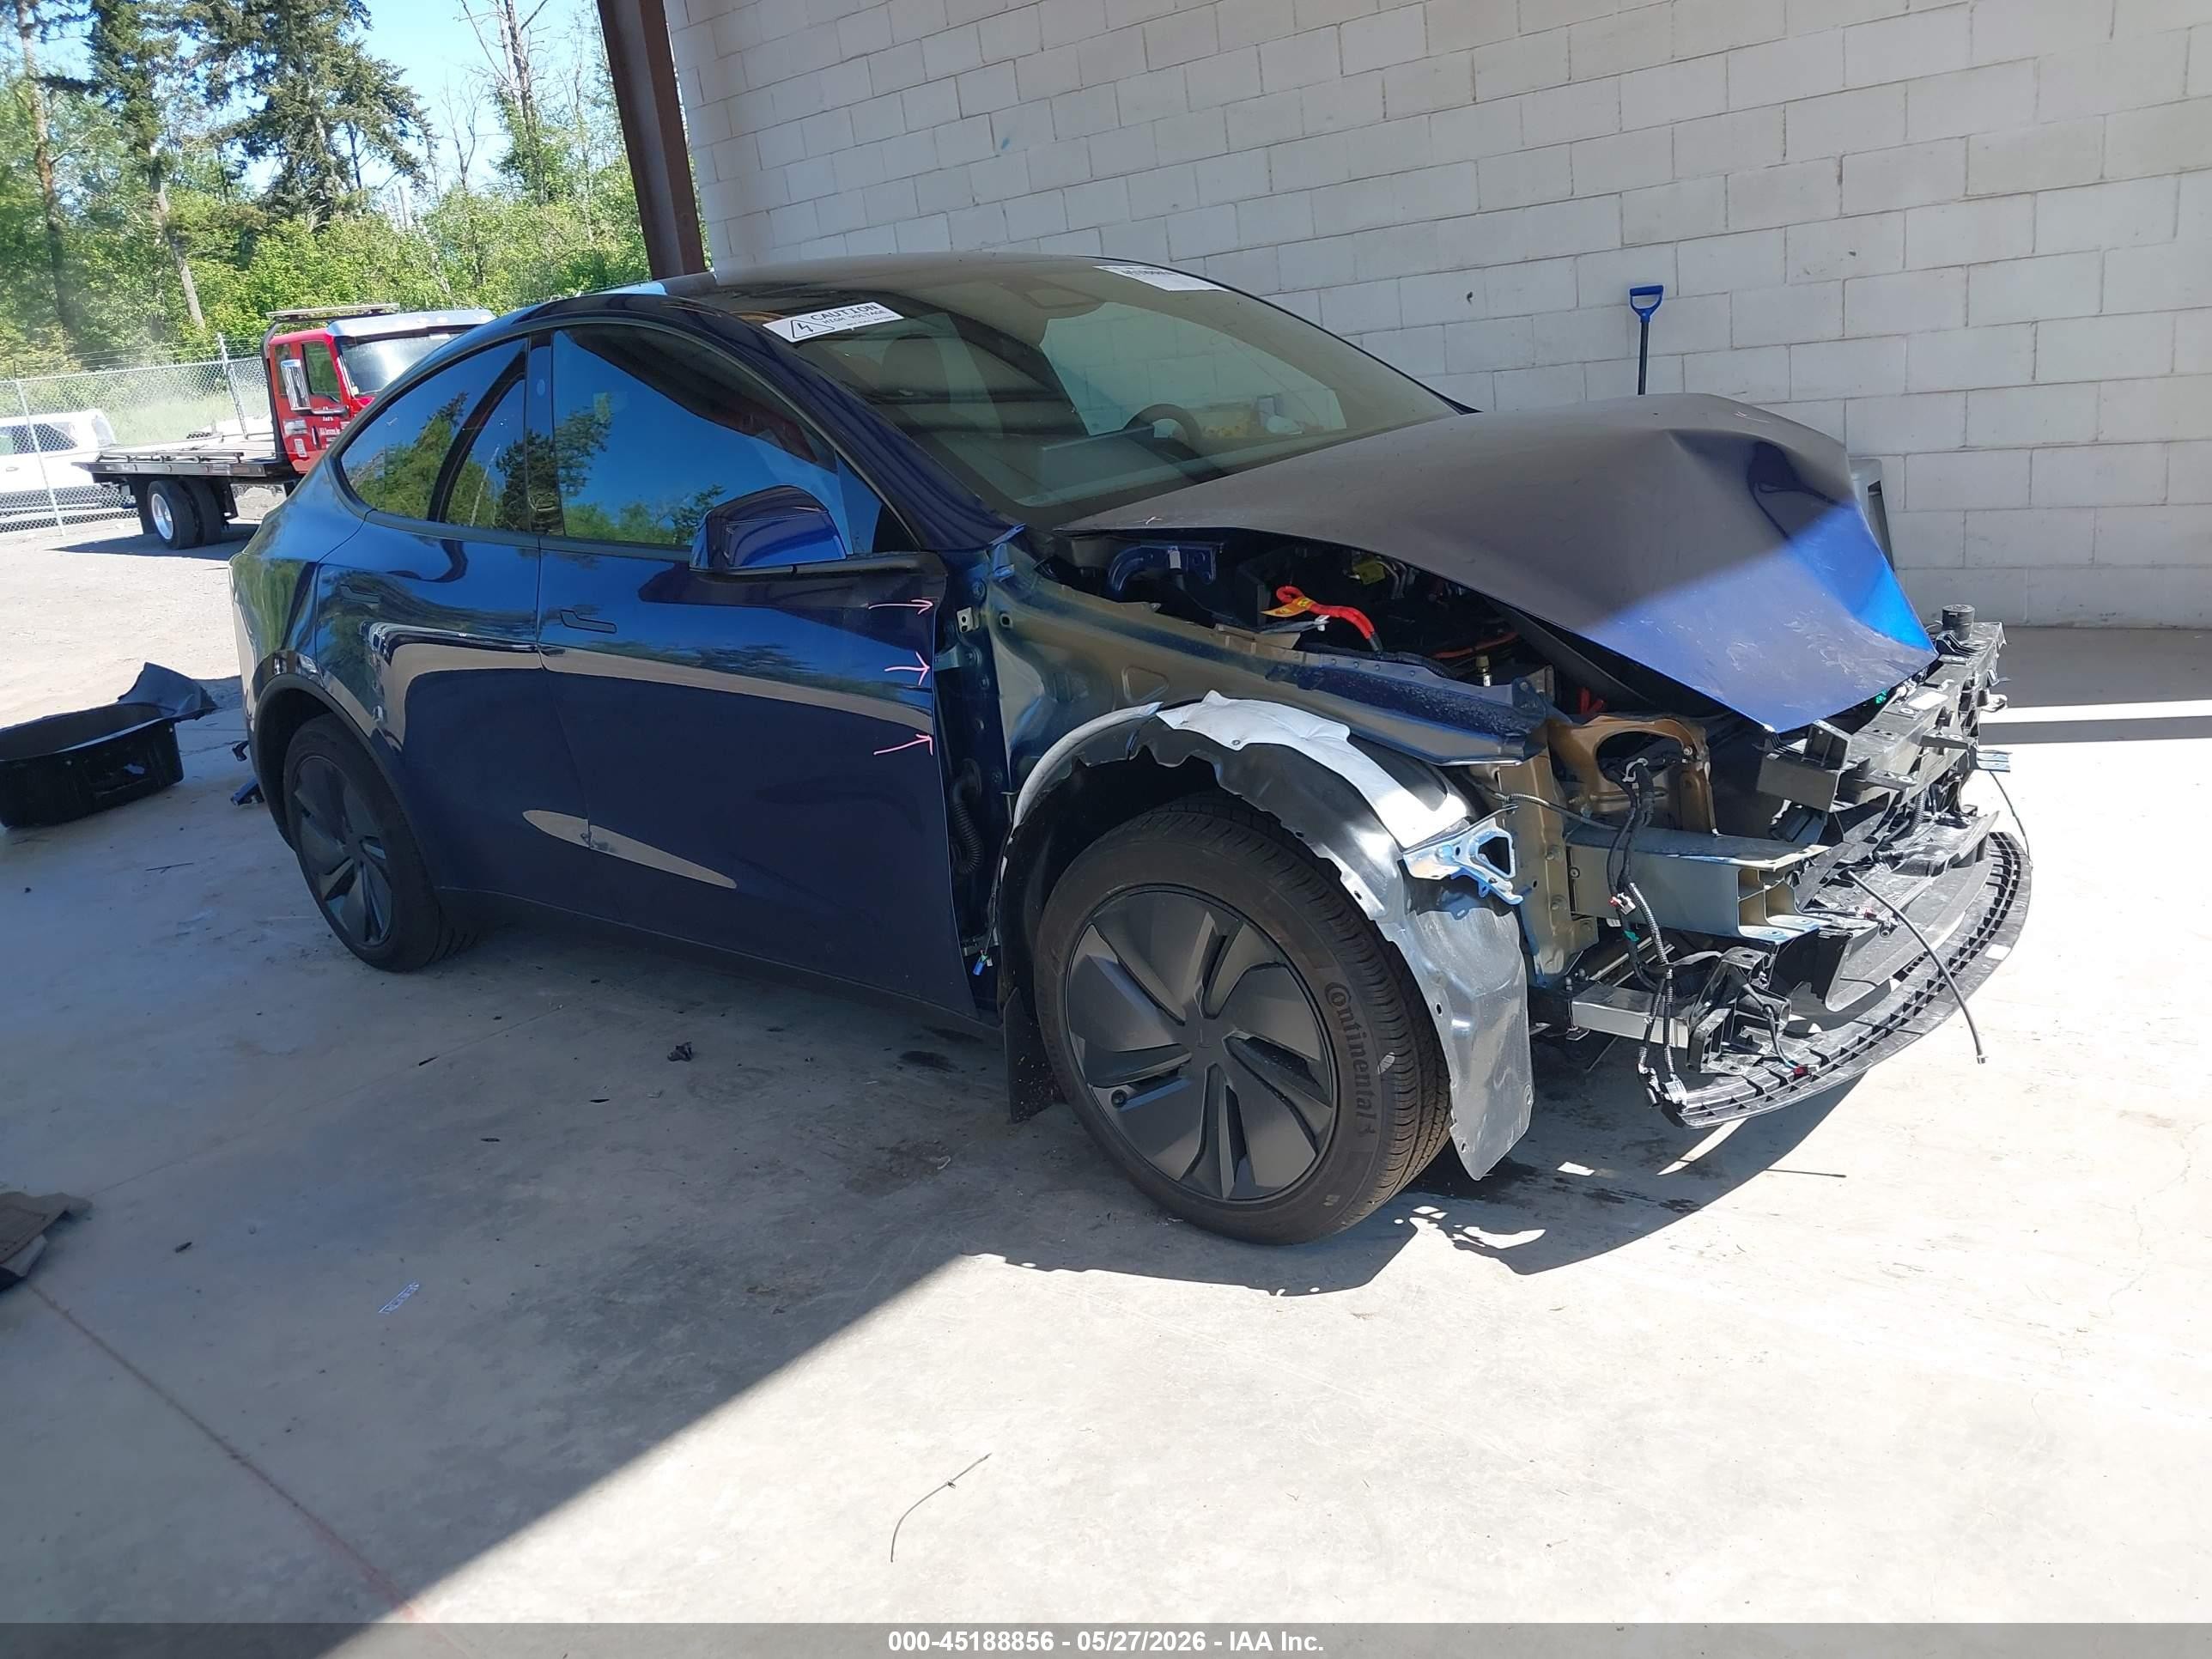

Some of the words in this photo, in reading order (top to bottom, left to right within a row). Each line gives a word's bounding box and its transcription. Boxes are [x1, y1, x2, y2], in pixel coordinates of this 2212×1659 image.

[811, 304, 879, 320] CAUTION
[822, 316, 847, 325] HIGH
[848, 309, 886, 319] VOLTAGE
[1325, 981, 1376, 1120] Continental
